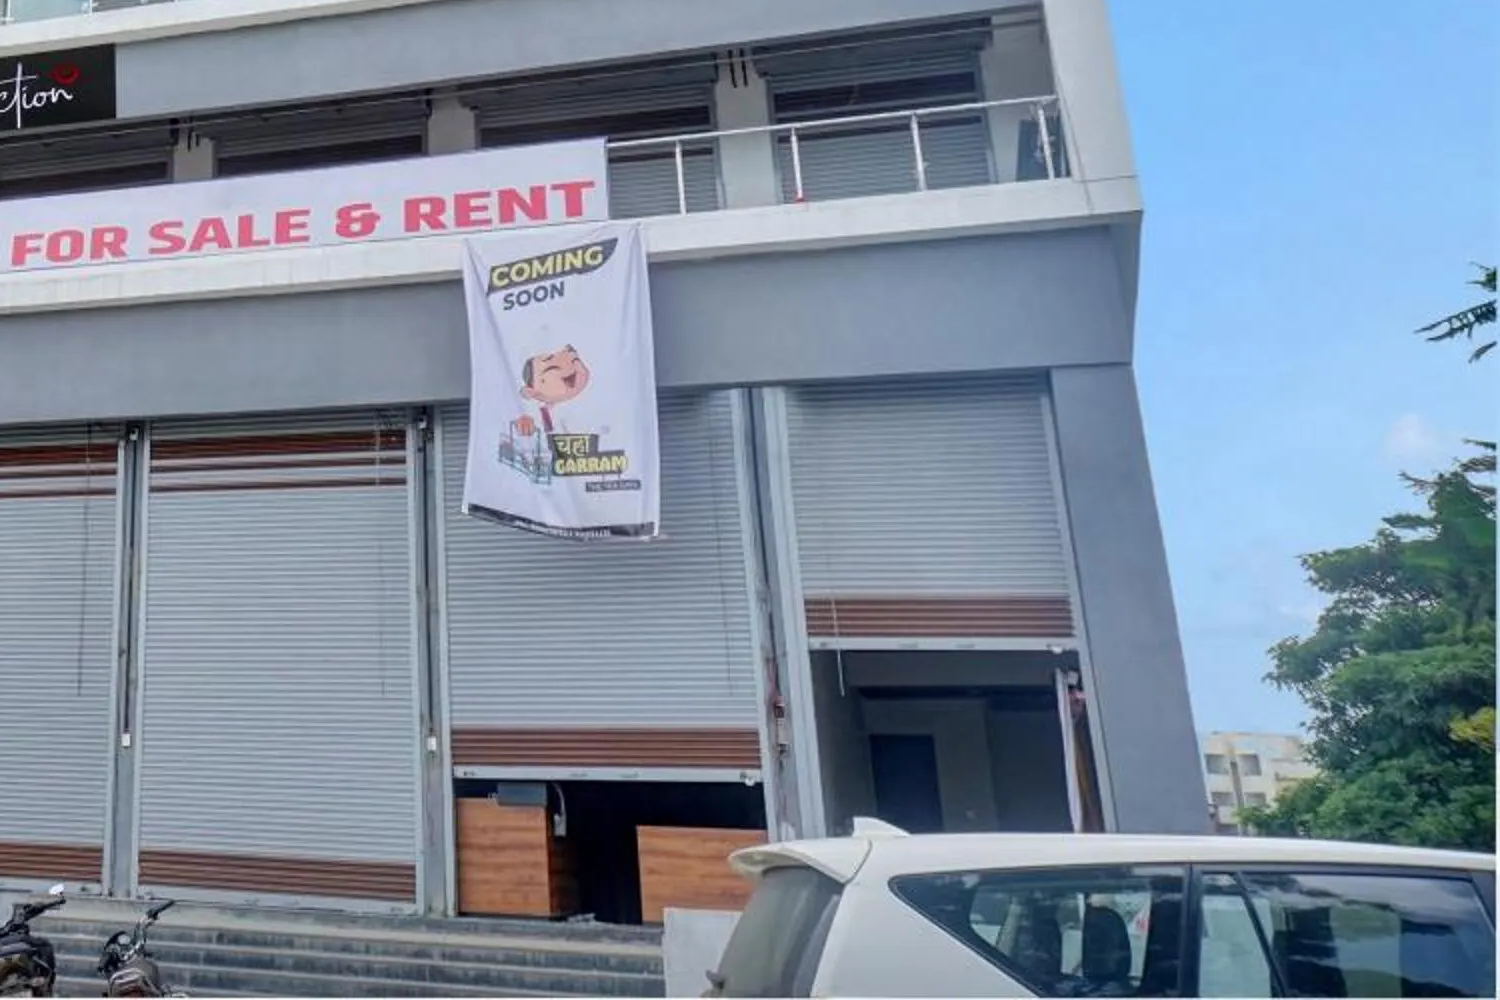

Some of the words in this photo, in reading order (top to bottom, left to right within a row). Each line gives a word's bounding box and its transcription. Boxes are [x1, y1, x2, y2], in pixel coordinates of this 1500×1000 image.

[10, 225, 129, 267] FOR
[148, 208, 311, 255] SALE
[335, 203, 381, 239] &
[403, 180, 595, 233] RENT
[490, 245, 605, 287] COMING
[502, 281, 566, 311] SOON
[555, 455, 627, 475] GARRAM
